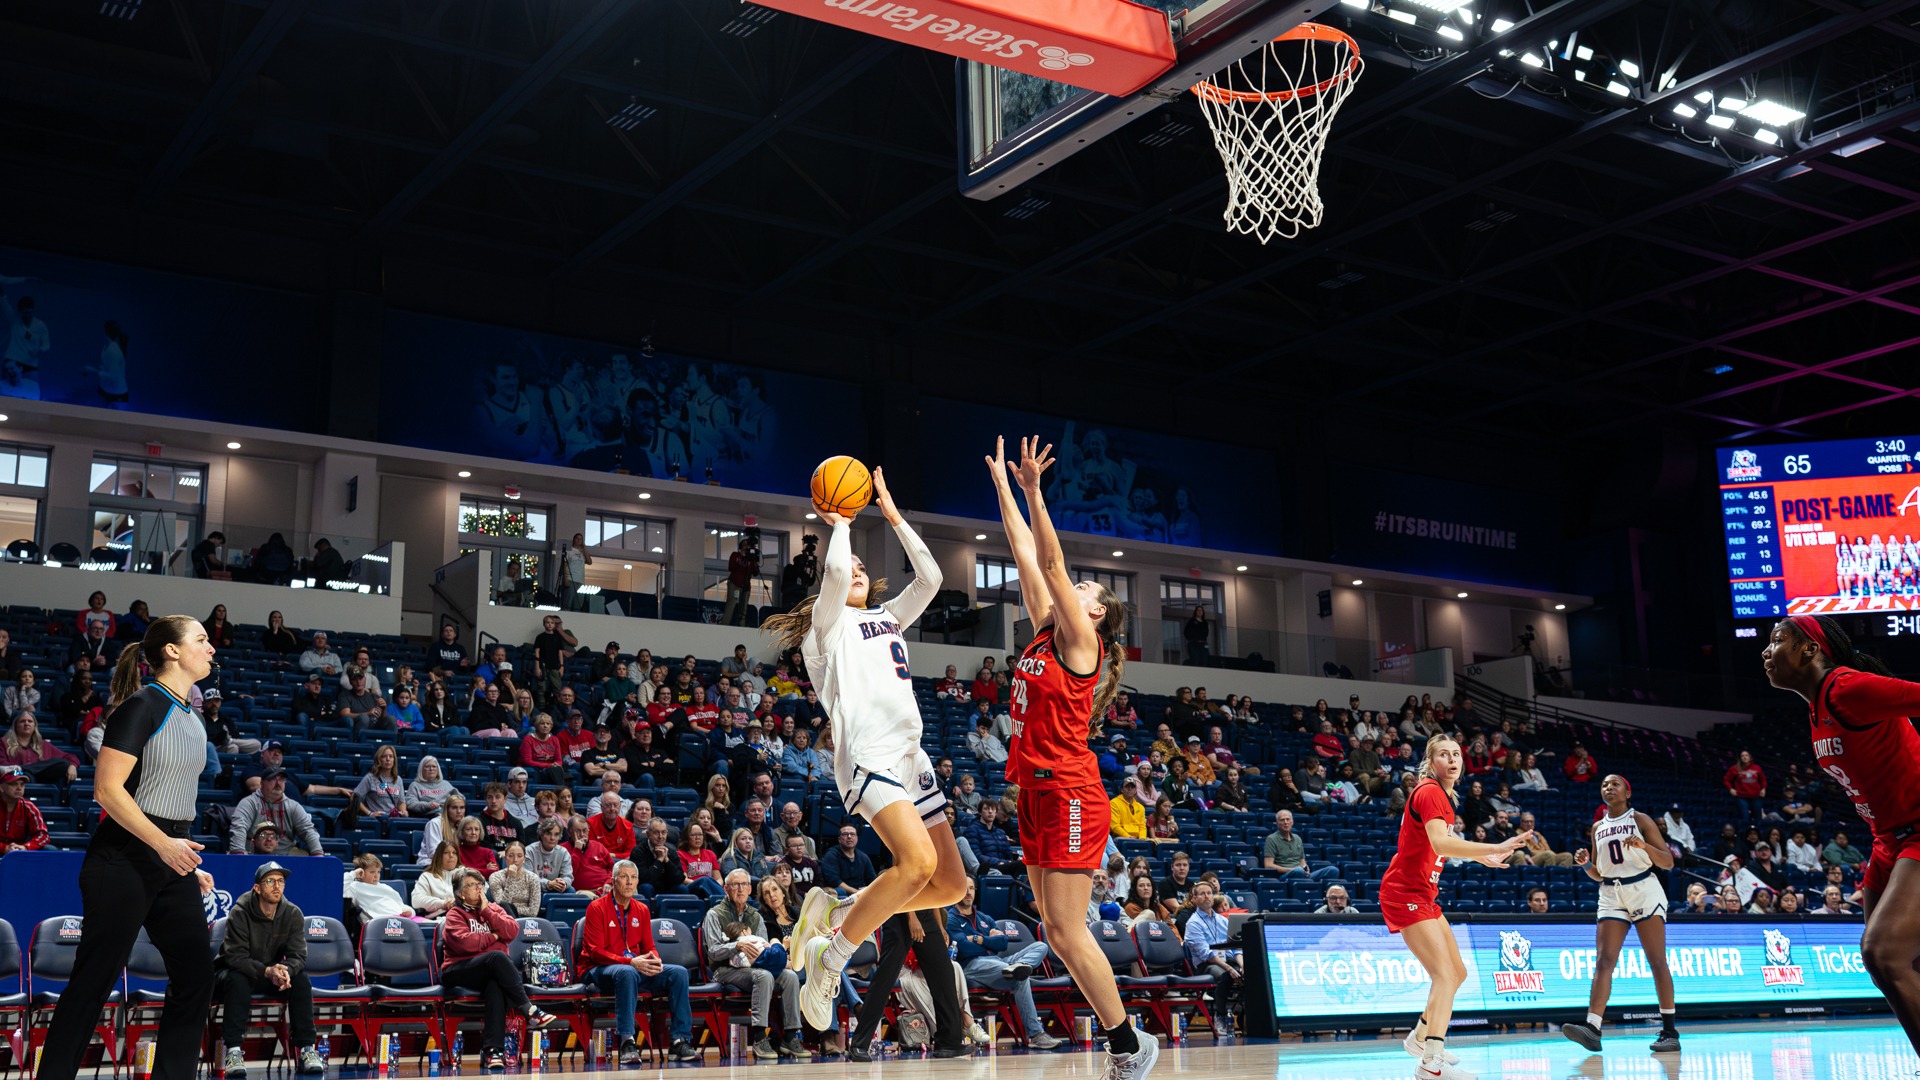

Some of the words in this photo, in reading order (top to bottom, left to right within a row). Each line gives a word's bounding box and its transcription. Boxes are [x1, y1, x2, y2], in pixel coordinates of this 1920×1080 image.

[1876, 439, 1906, 453] 3:40
[1784, 455, 1811, 474] 65
[1867, 454, 1911, 464] QUARTER:
[1878, 464, 1903, 473] POSS
[1724, 492, 1743, 500] FG%
[1748, 491, 1768, 500] 45.6
[1725, 507, 1748, 515] 3PT%
[1754, 506, 1766, 514] 20
[1782, 494, 1896, 523] POST-GAME
[1091, 514, 1111, 531] 33
[1727, 522, 1745, 530] FT%
[1751, 520, 1771, 529] 69.2
[1375, 511, 1517, 549] #ITSBRUINTIME
[1729, 537, 1746, 545] REB
[1757, 535, 1769, 544] 24
[1730, 552, 1746, 560] AST
[1760, 550, 1771, 558] 13
[1761, 565, 1772, 573] 10
[1770, 581, 1777, 589] 5
[1735, 594, 1767, 603] BONUS:
[1773, 605, 1780, 614] 3
[889, 641, 911, 680] 9
[1467, 666, 1482, 676] 106
[1012, 721, 1025, 738] TATE
[1069, 799, 1081, 853] REDBIRDS
[1608, 839, 1625, 865] 0
[1812, 945, 1866, 973] Ticke
[1275, 951, 1432, 986] TicketSma
[1559, 949, 1652, 980] OFFIAL
[1666, 948, 1744, 977] ARTNER
[1495, 972, 1543, 992] BELMONT
[1762, 967, 1803, 984] BELMONT
